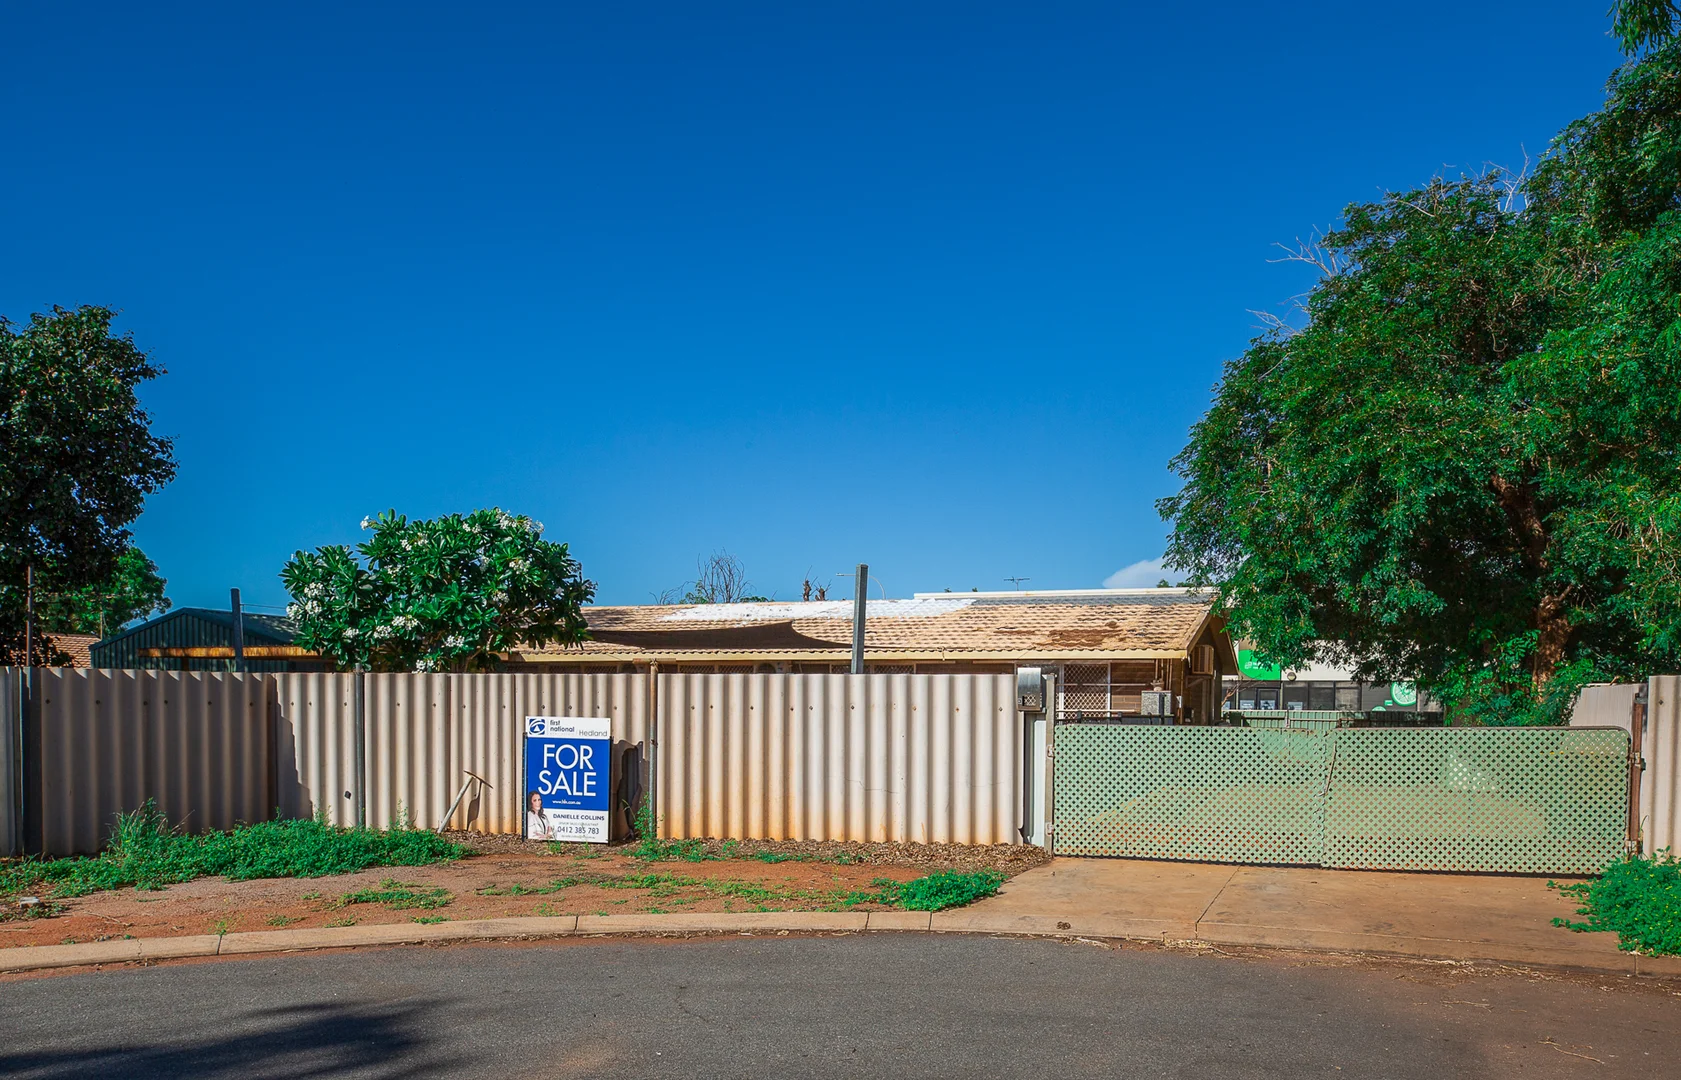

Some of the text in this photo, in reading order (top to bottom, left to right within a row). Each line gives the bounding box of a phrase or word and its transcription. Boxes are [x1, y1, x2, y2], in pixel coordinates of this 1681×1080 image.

[543, 744, 594, 770] FOR
[537, 770, 597, 797] SALE
[588, 827, 600, 835] 783
